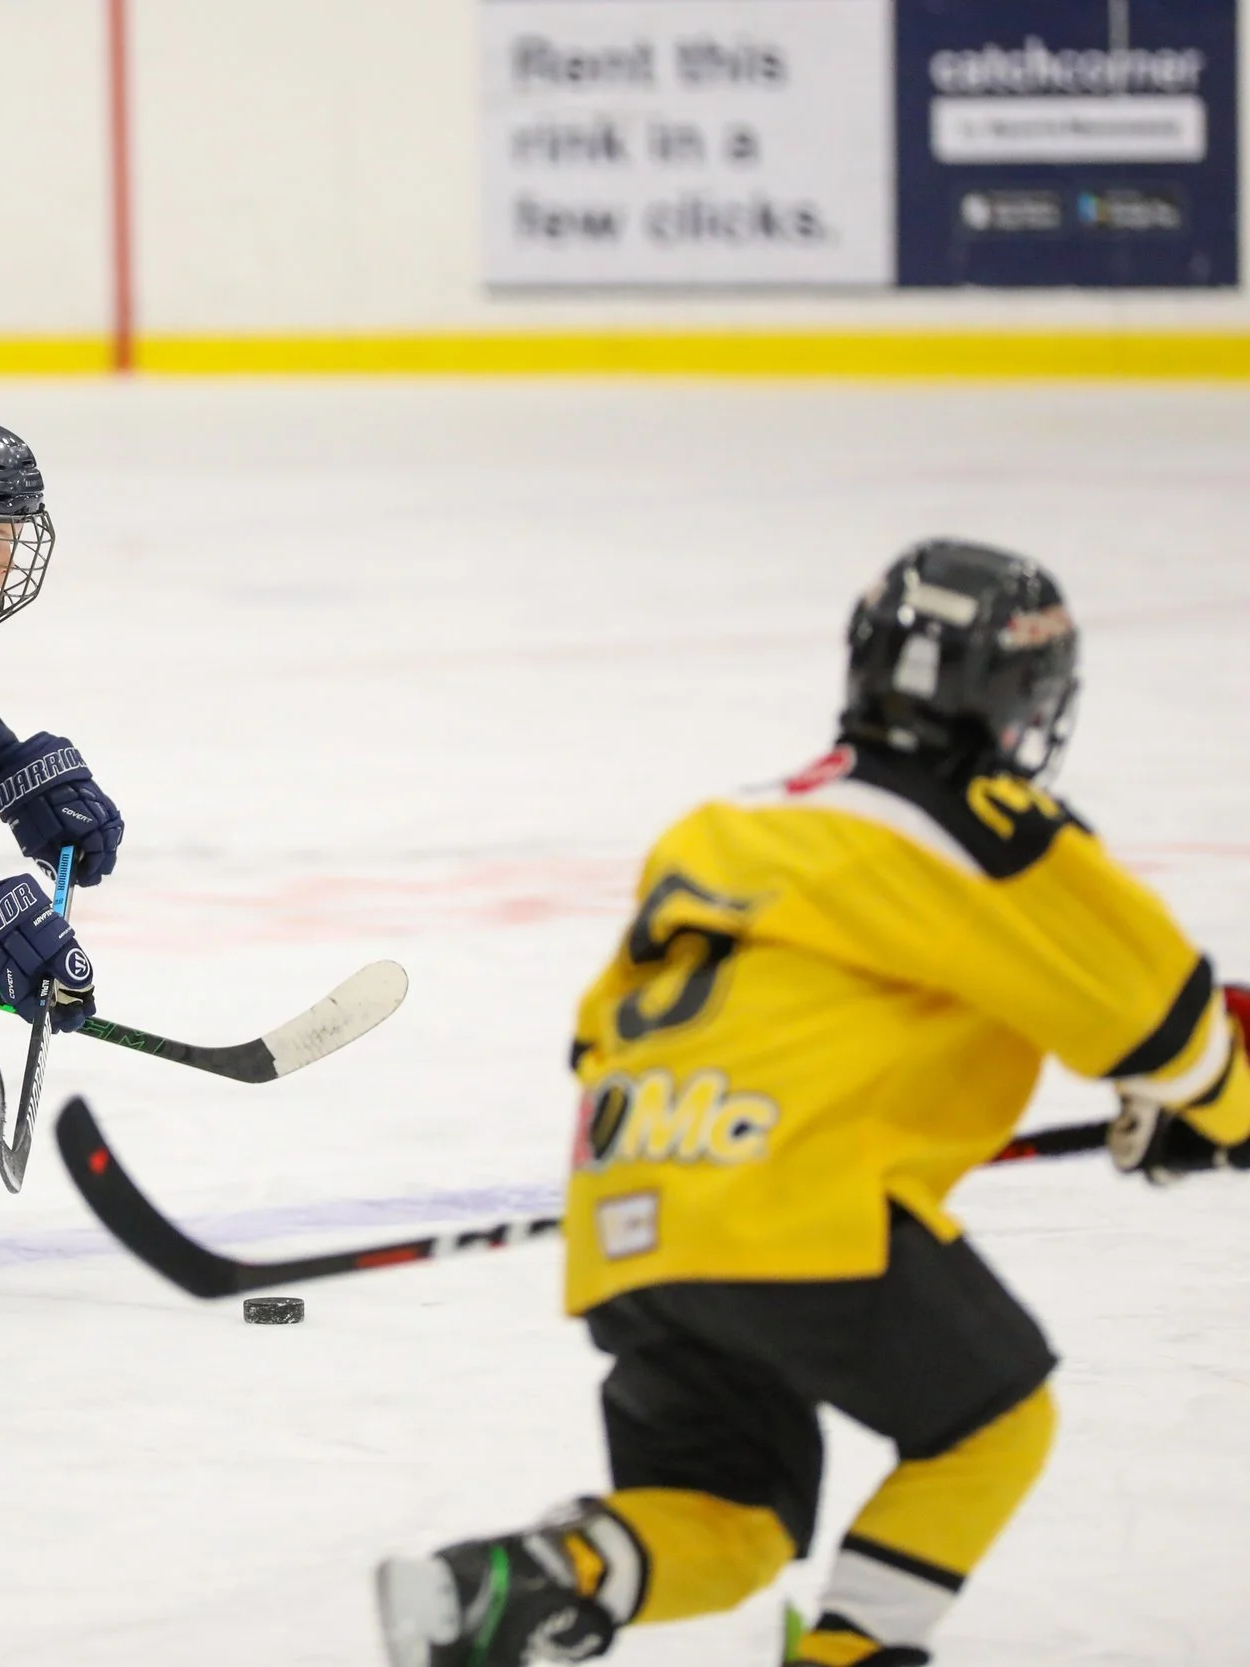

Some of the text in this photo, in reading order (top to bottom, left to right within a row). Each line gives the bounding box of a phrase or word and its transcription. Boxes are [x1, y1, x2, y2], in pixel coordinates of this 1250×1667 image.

[674, 36, 786, 88] this
[511, 118, 761, 167] rink in a
[514, 192, 618, 241] few
[61, 807, 93, 823] COVERT
[54, 853, 70, 892] WARRIOR
[5, 967, 16, 999] COVERT
